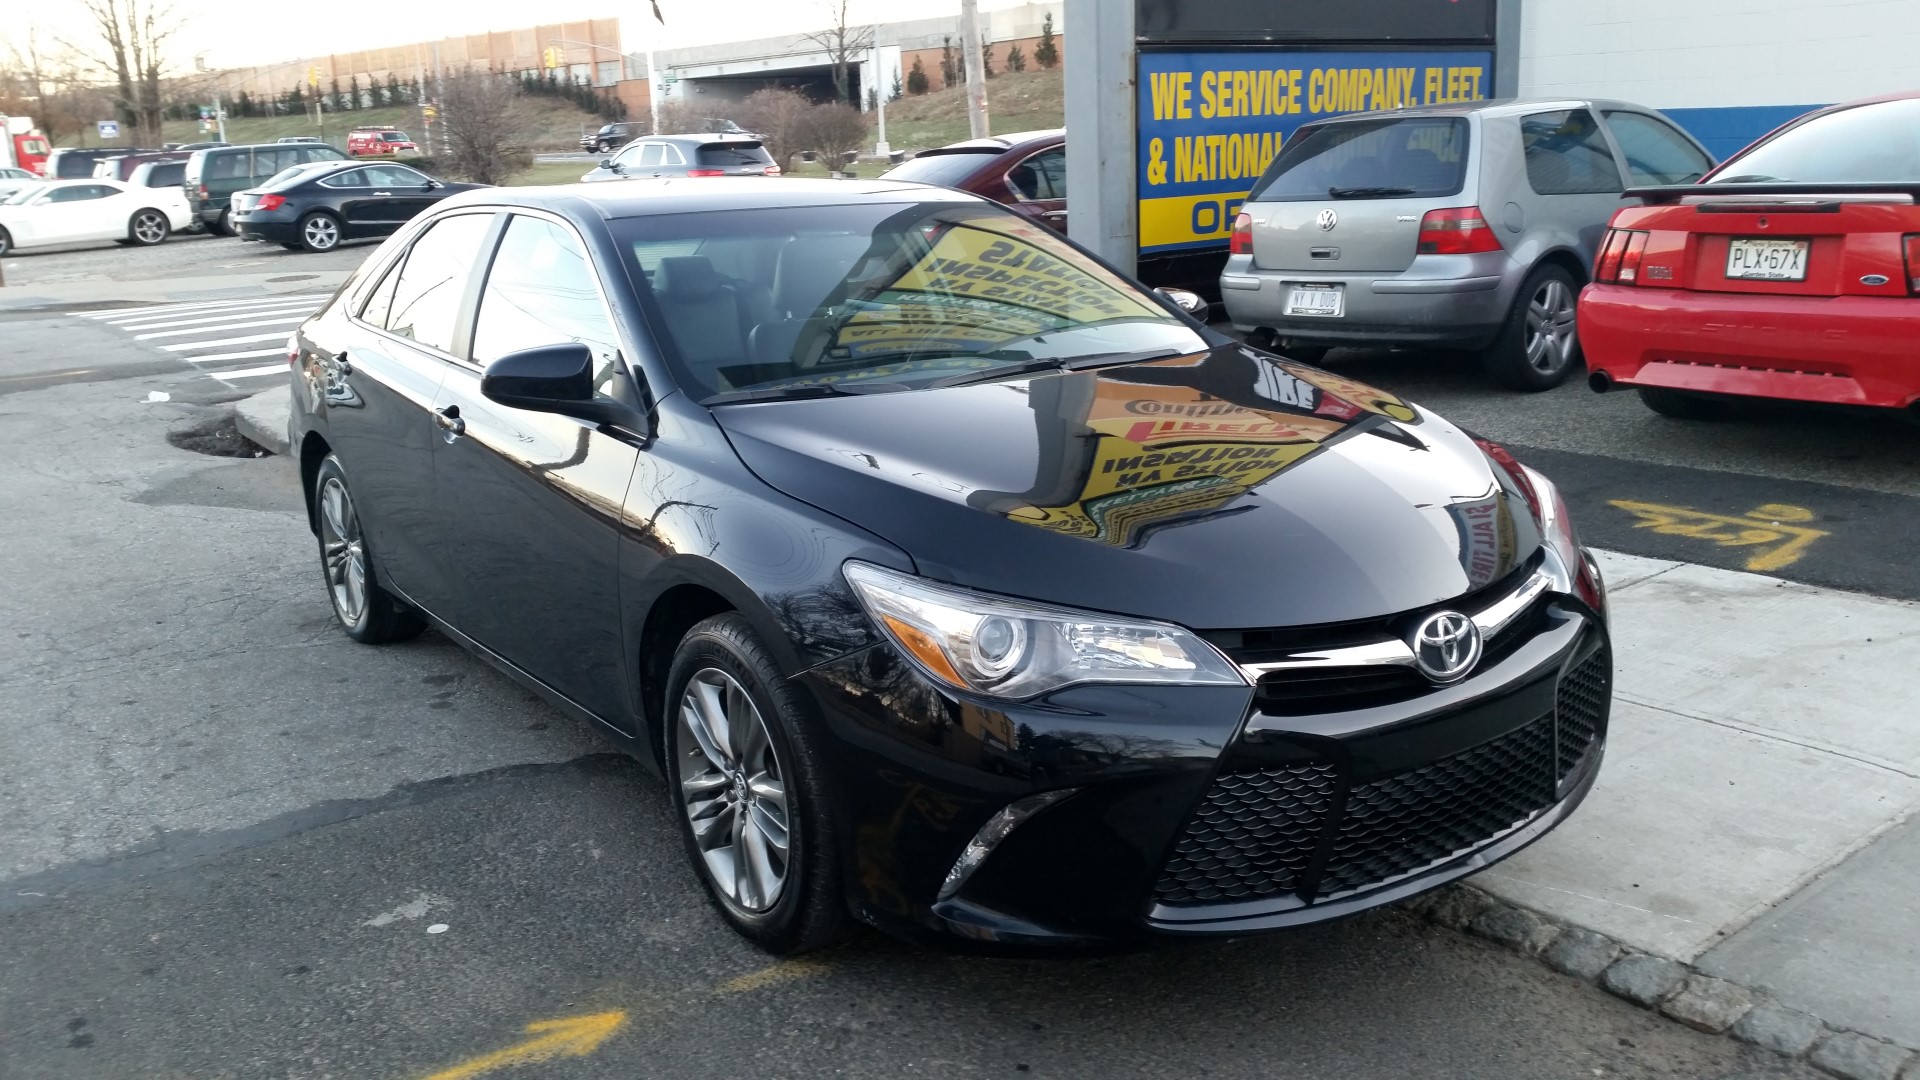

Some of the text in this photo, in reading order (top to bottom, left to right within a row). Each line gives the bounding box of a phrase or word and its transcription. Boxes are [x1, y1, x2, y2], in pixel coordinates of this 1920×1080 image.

[1150, 71, 1193, 120] WE
[1200, 69, 1302, 119] SERVICE
[1147, 137, 1168, 186] &
